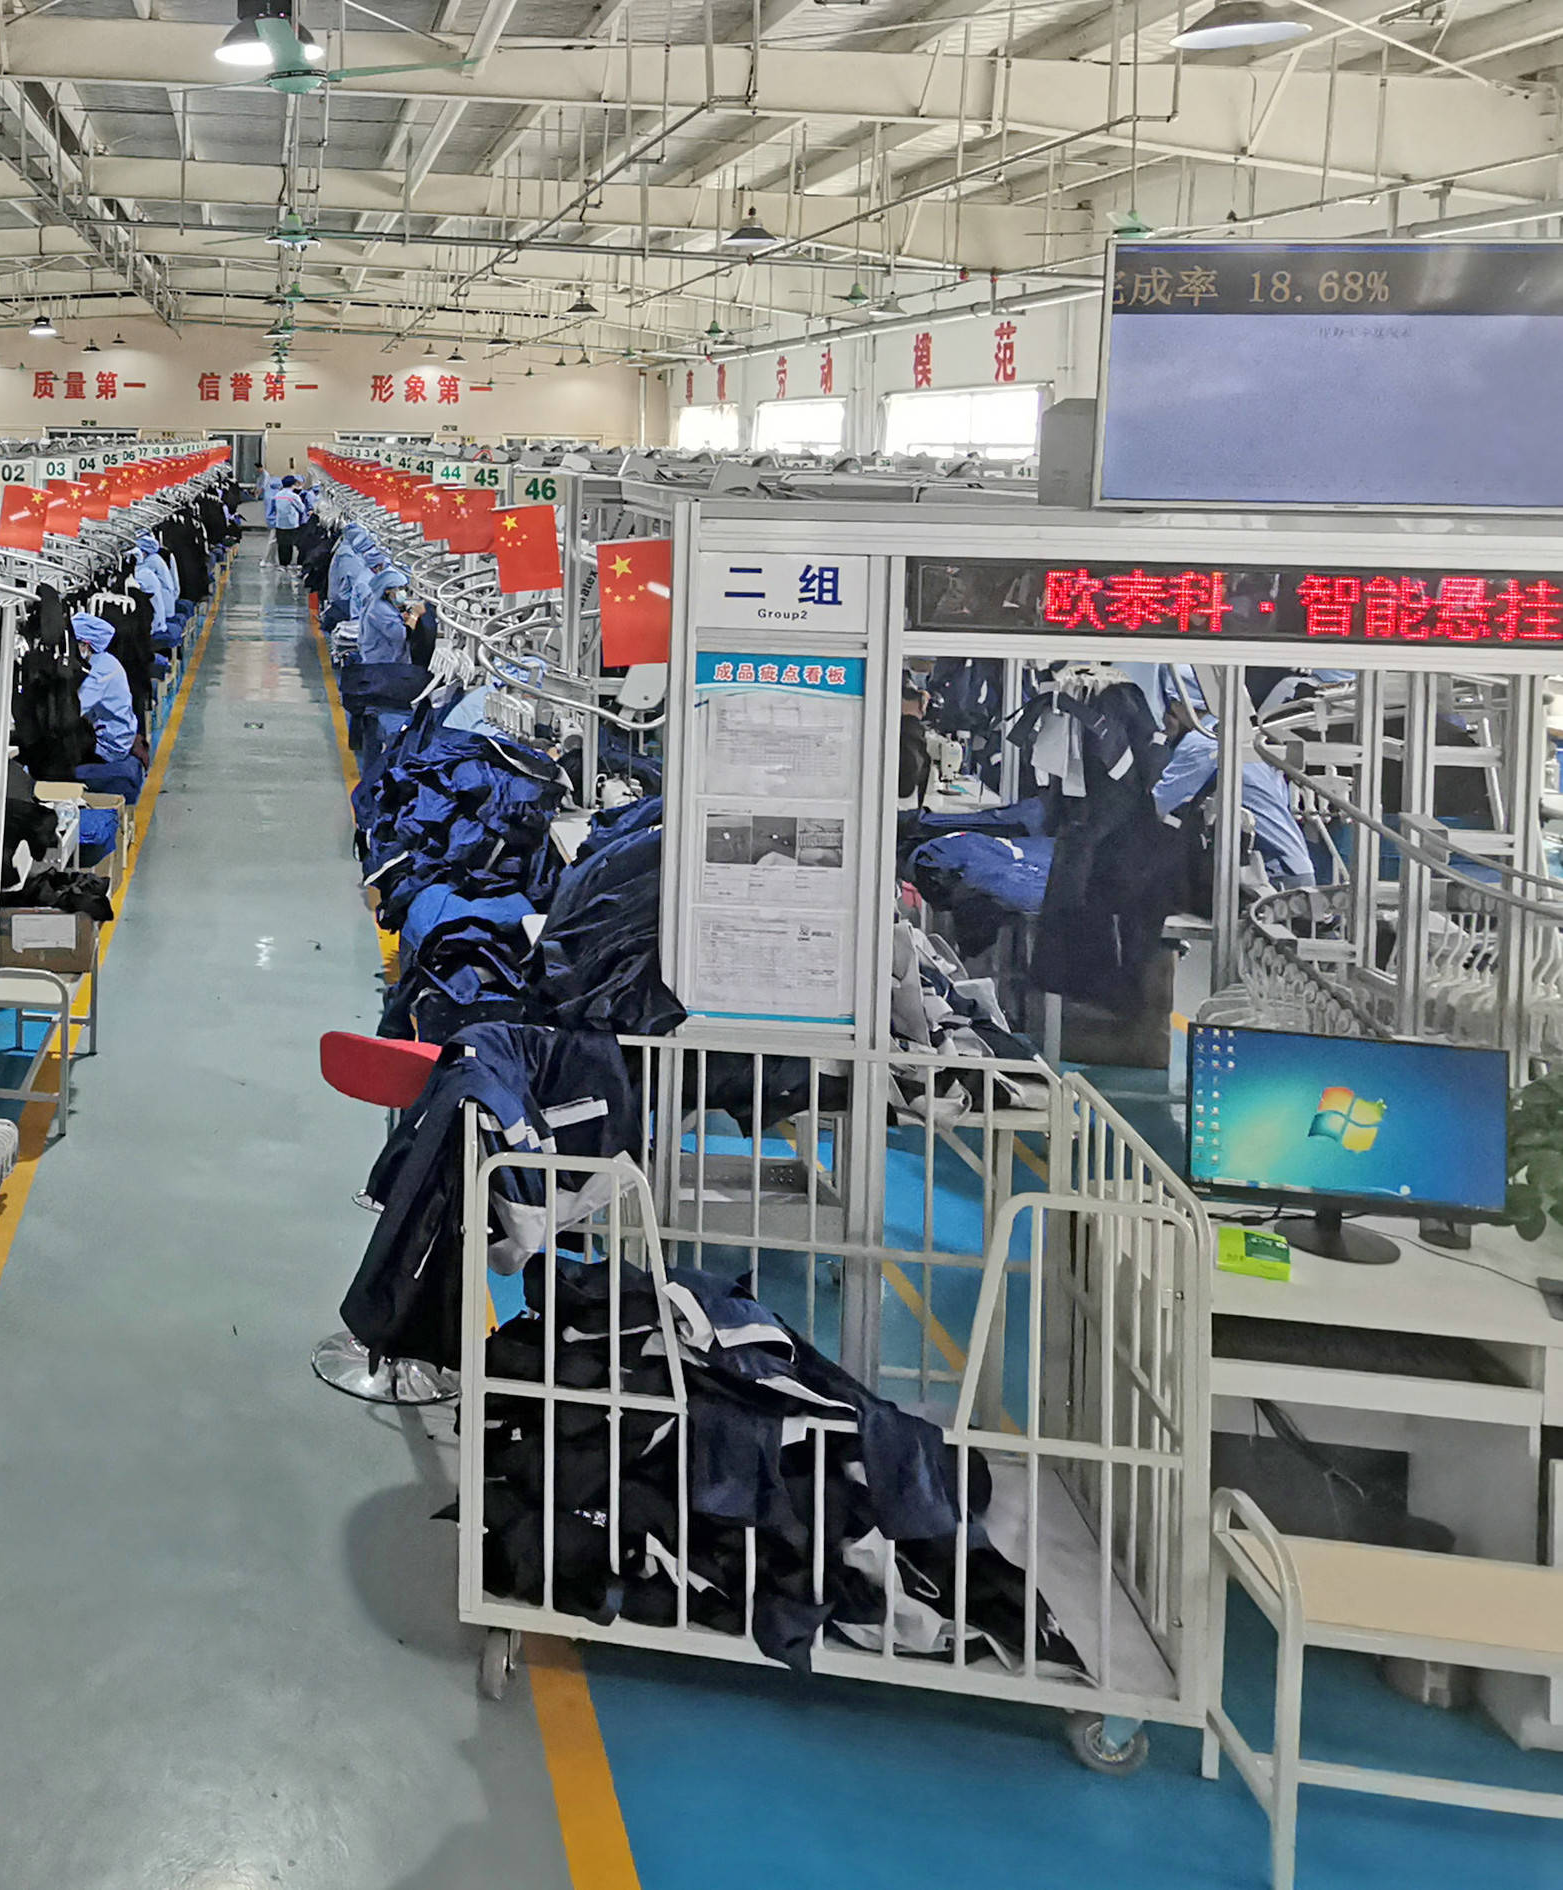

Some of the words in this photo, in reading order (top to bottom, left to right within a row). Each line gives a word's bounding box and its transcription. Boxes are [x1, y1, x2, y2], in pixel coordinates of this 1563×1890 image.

[1249, 270, 1390, 303] 18.68%
[32, 370, 147, 400] 质量第一
[198, 372, 319, 402] 信誉第一
[371, 374, 493, 404] 形象第一
[79, 457, 96, 470] 04
[102, 454, 118, 466] 05
[123, 450, 135, 461] 06
[1, 464, 25, 482] 02
[46, 462, 66, 476] 03
[416, 460, 434, 474] 43
[440, 465, 462, 480] 44
[1017, 466, 1033, 478] 41
[474, 469, 499, 487] 45
[525, 478, 557, 501] 46
[724, 564, 843, 606] 二组
[757, 607, 808, 621] Group2
[714, 661, 846, 685] 成品疵点看板
